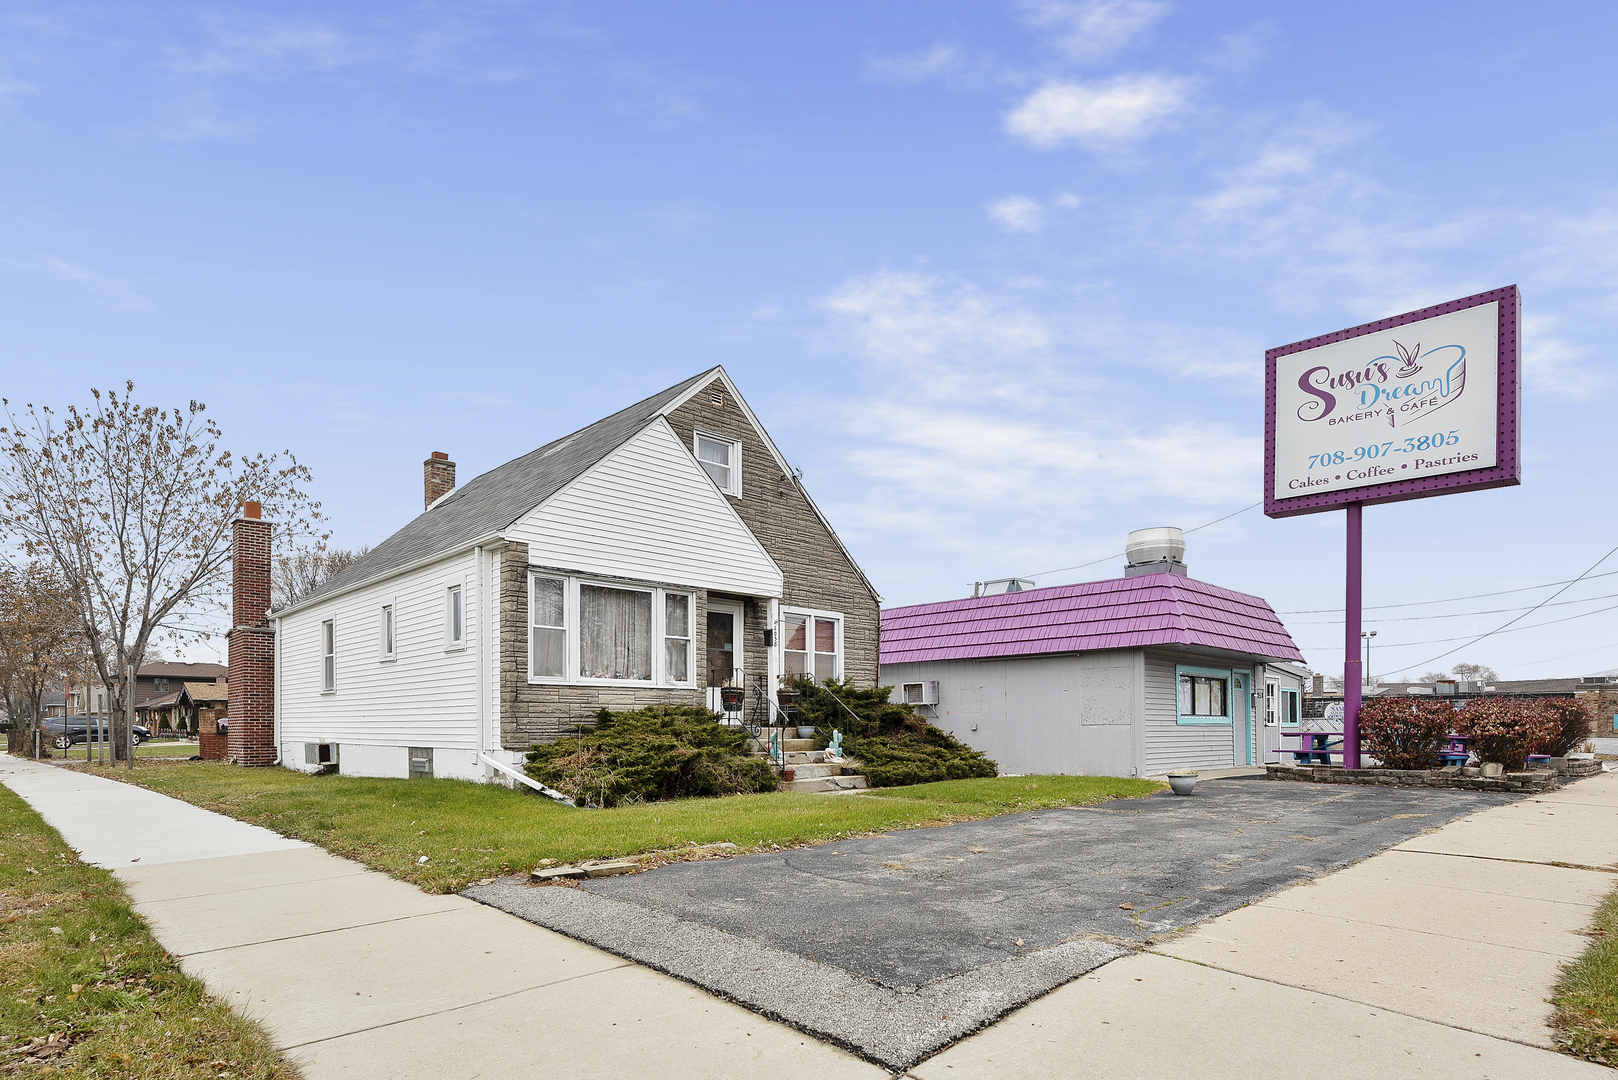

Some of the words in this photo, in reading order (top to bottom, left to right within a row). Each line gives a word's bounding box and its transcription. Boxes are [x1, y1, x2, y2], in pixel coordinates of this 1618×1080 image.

[1296, 361, 1390, 422] Susu's
[1354, 377, 1449, 411] Dream
[1328, 409, 1383, 426] BAKERY
[1386, 406, 1395, 415] &
[1400, 396, 1439, 413] CAFÉ
[1308, 428, 1461, 469] 708-907-3805
[1288, 476, 1330, 490] Cakes
[1346, 465, 1395, 481] Coffee
[1414, 452, 1479, 470] Pastries
